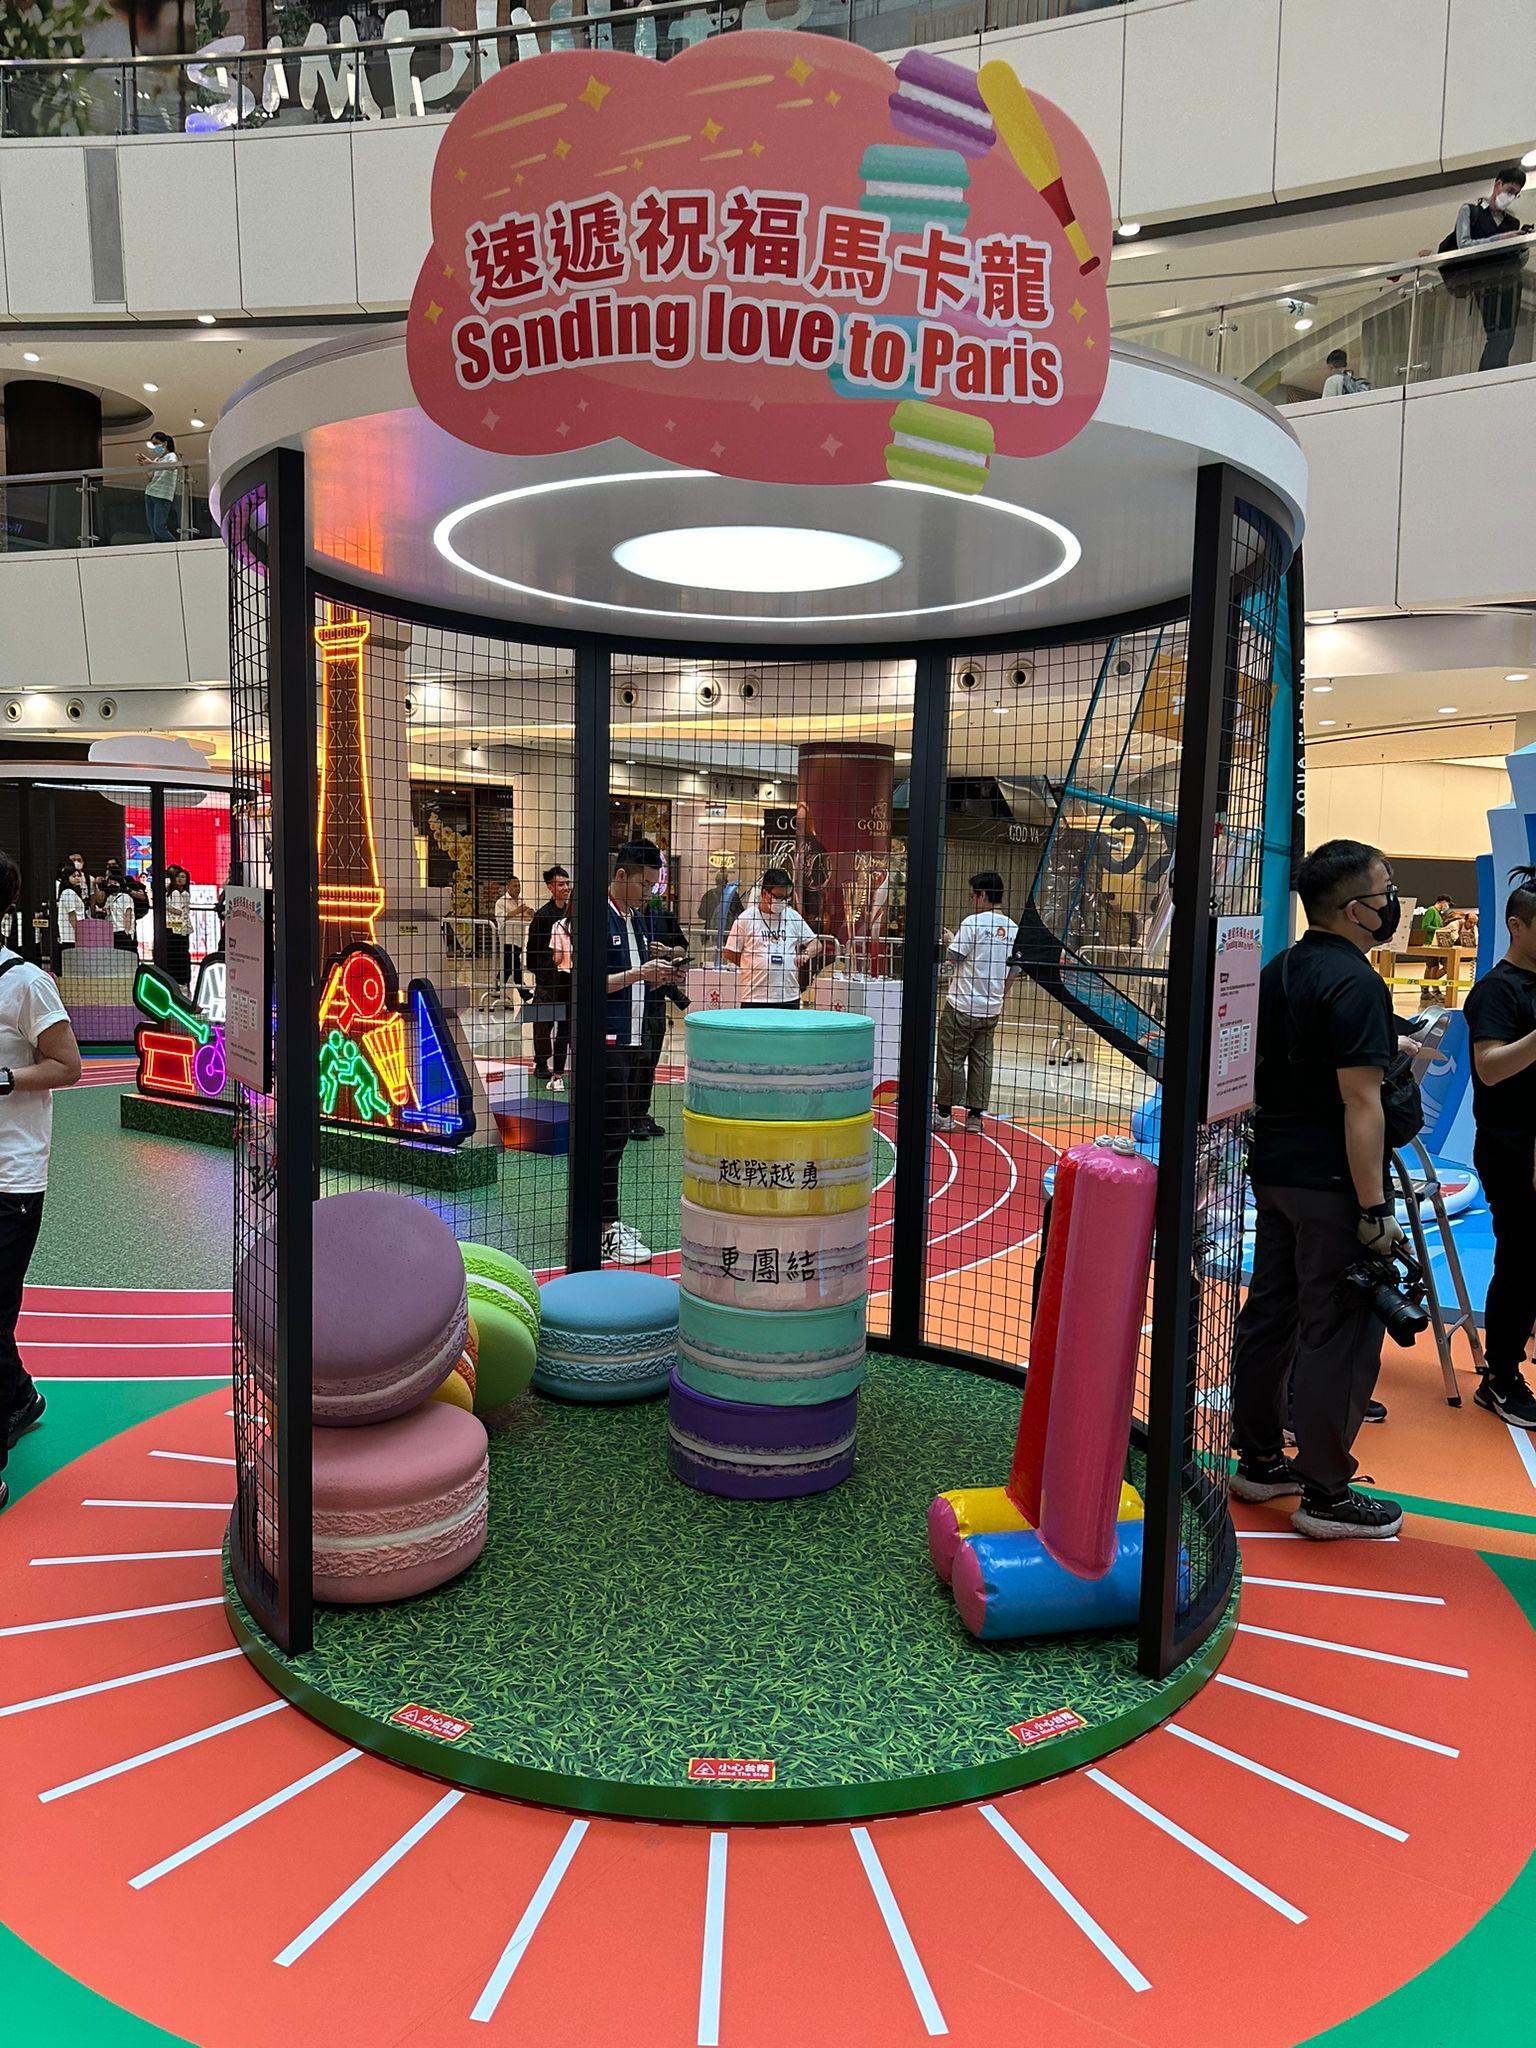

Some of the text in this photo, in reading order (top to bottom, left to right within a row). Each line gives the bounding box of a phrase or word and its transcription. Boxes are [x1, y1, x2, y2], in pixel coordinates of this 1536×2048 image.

[470, 195, 1050, 323] 速遞祝福馬卡龍
[458, 291, 1058, 399] Sending love to Paris
[1009, 824, 1040, 844] GODVA
[718, 1158, 818, 1190] 越戰越勇
[720, 1245, 817, 1285] 更團結
[718, 1763, 770, 1773] 小心台階
